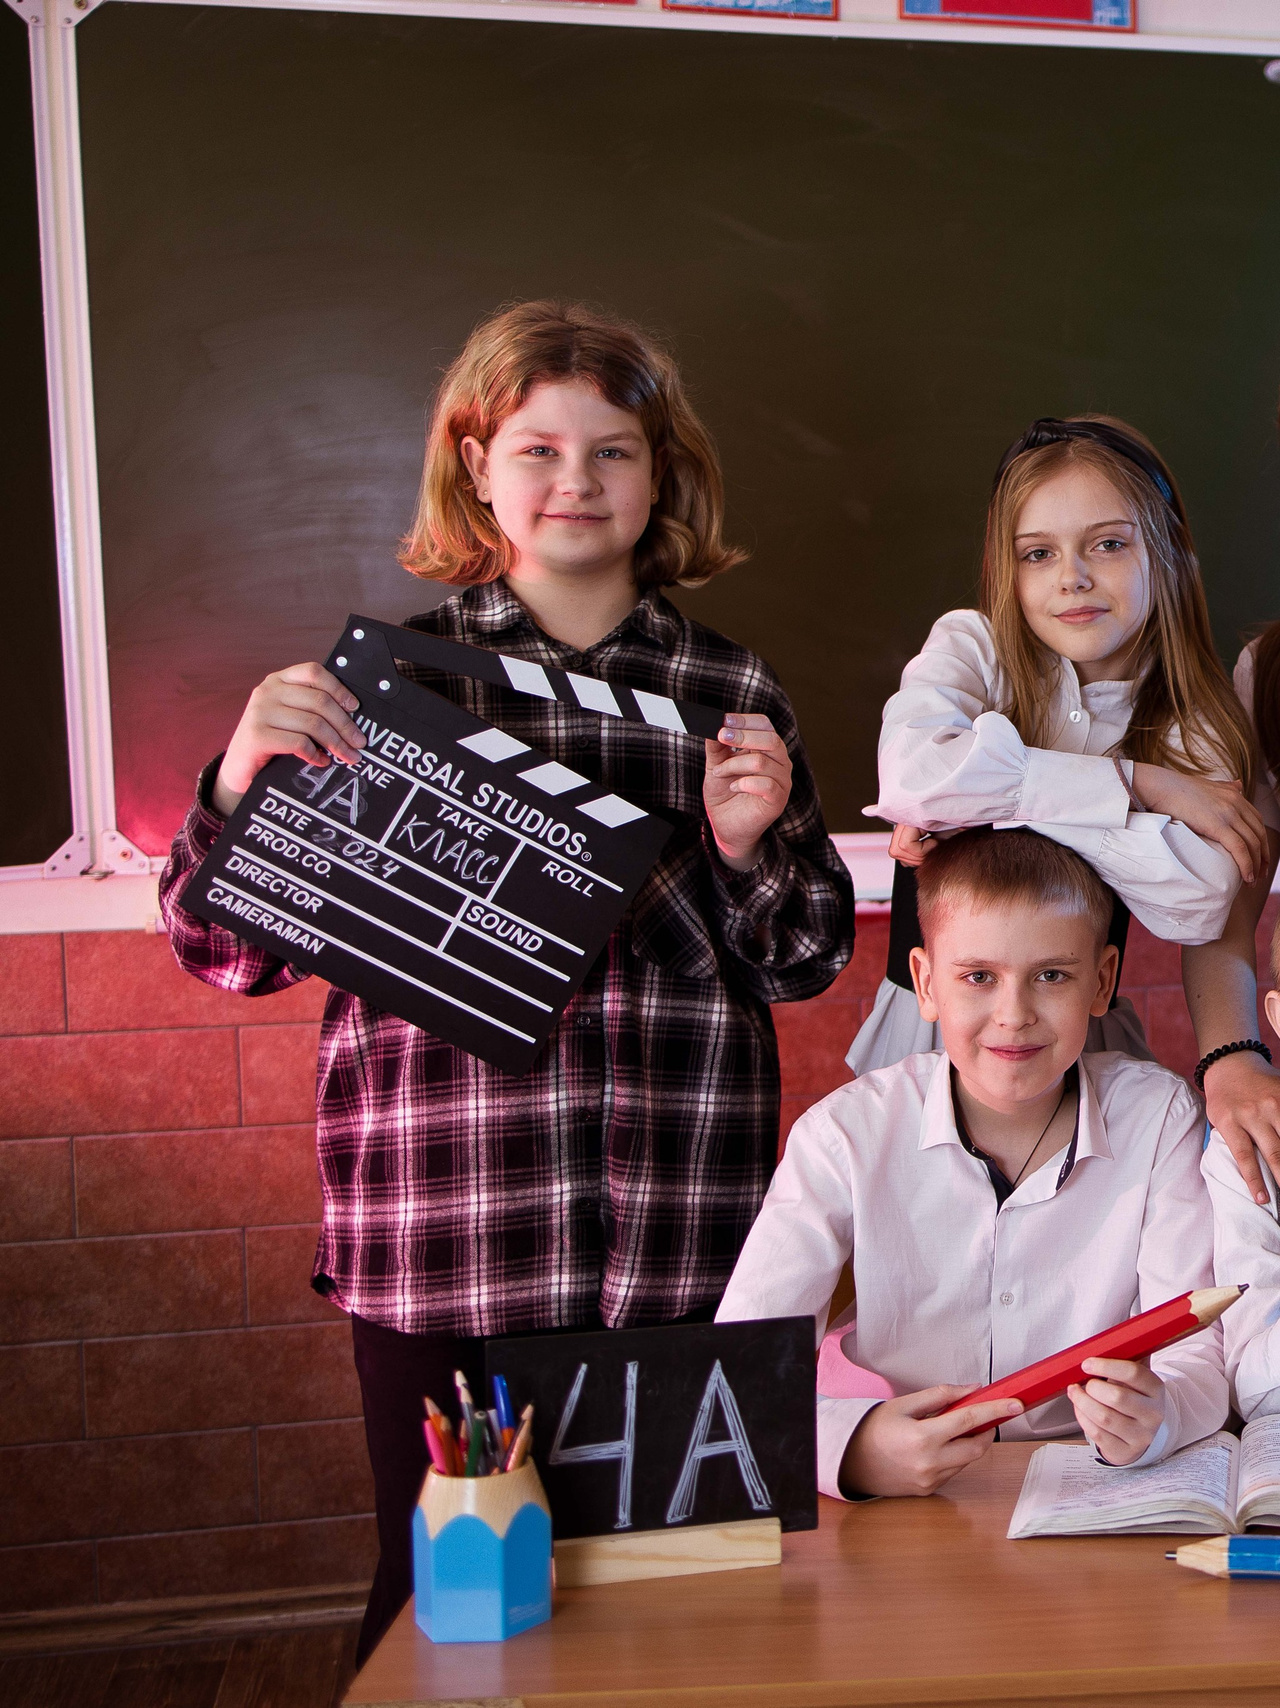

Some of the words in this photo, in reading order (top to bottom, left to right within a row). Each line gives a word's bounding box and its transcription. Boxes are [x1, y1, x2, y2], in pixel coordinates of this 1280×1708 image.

[350, 712, 465, 797] IVERSAL
[259, 796, 312, 831] DATE
[436, 803, 493, 841] TAKE
[244, 823, 332, 879] PROD.CO.
[311, 827, 402, 879] 2024
[396, 813, 500, 885] КЛАСС
[225, 855, 324, 914] DIRECTOR
[541, 860, 595, 898] ROLL
[206, 887, 326, 954] CAMERAMAN
[466, 905, 543, 952] SOUND
